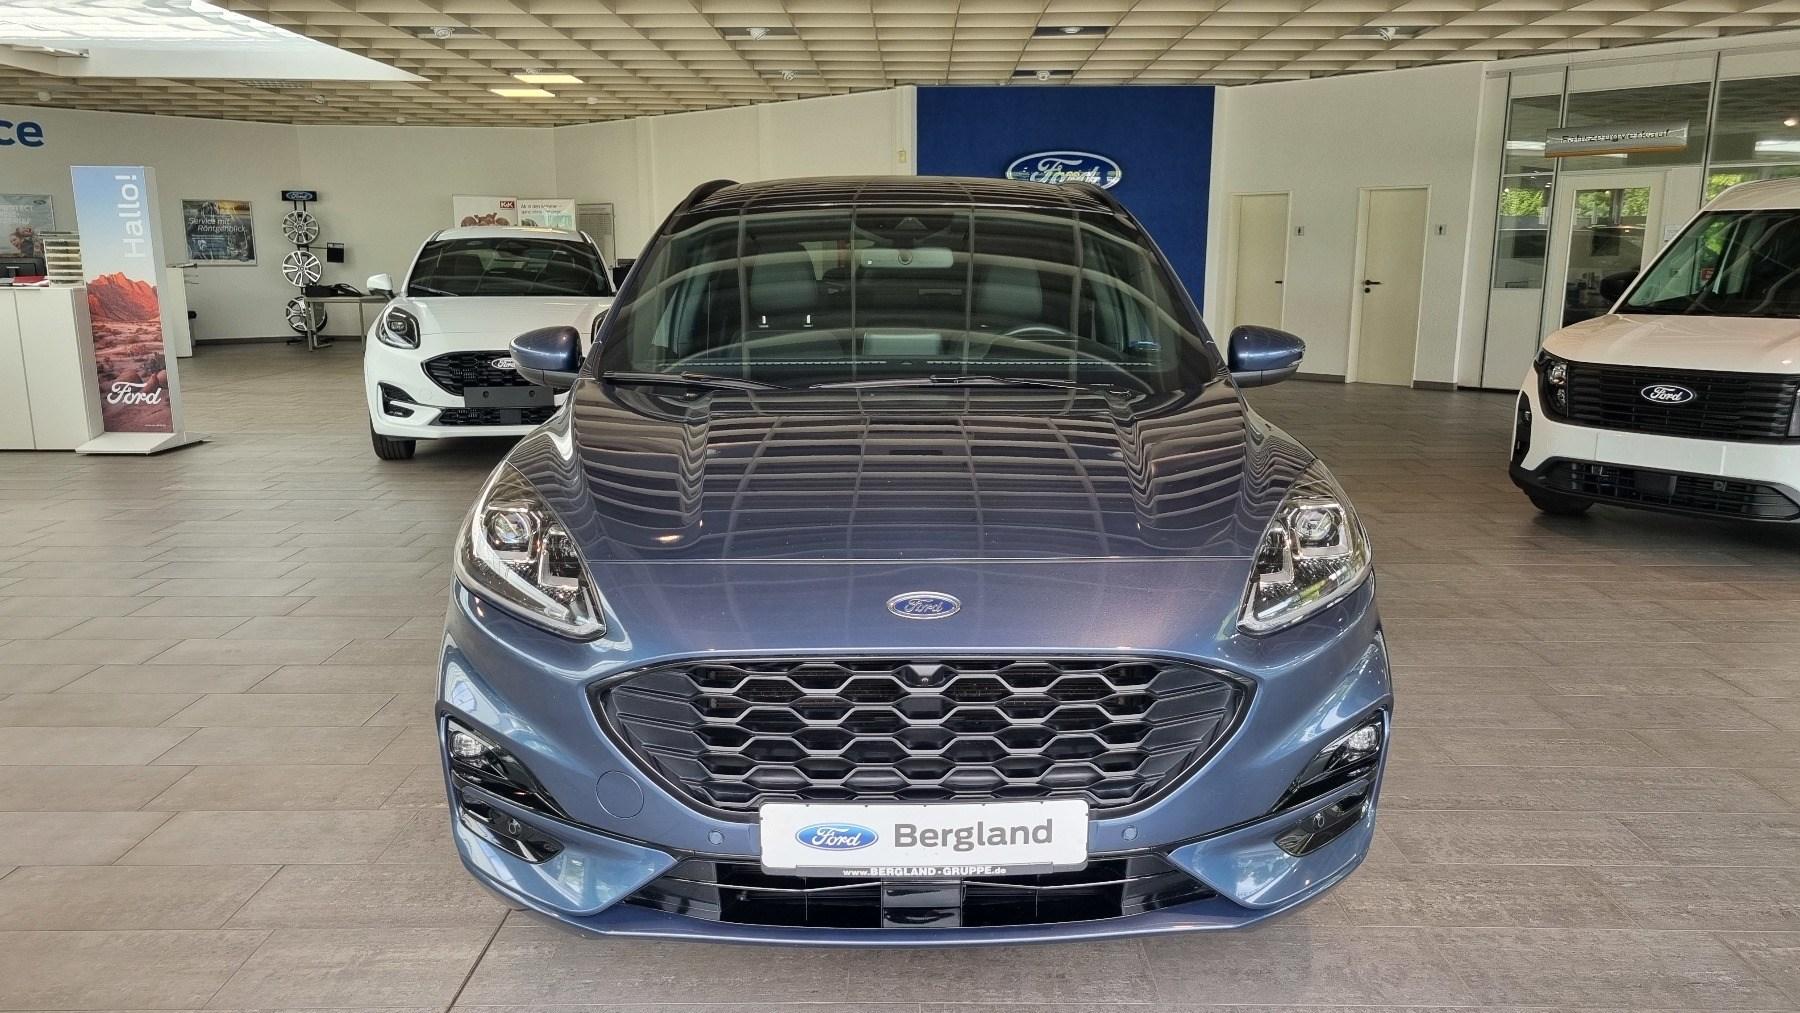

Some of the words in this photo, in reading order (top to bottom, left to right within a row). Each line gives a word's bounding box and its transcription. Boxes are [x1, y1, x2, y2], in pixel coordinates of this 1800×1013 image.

[114, 174, 146, 258] Hallo!
[188, 216, 216, 225] Service
[217, 217, 231, 225] mit
[106, 381, 162, 405] Ford
[1650, 387, 1683, 401] Ford
[904, 598, 943, 613] Ford
[811, 825, 861, 847] Ford
[894, 819, 1053, 852] Bergland
